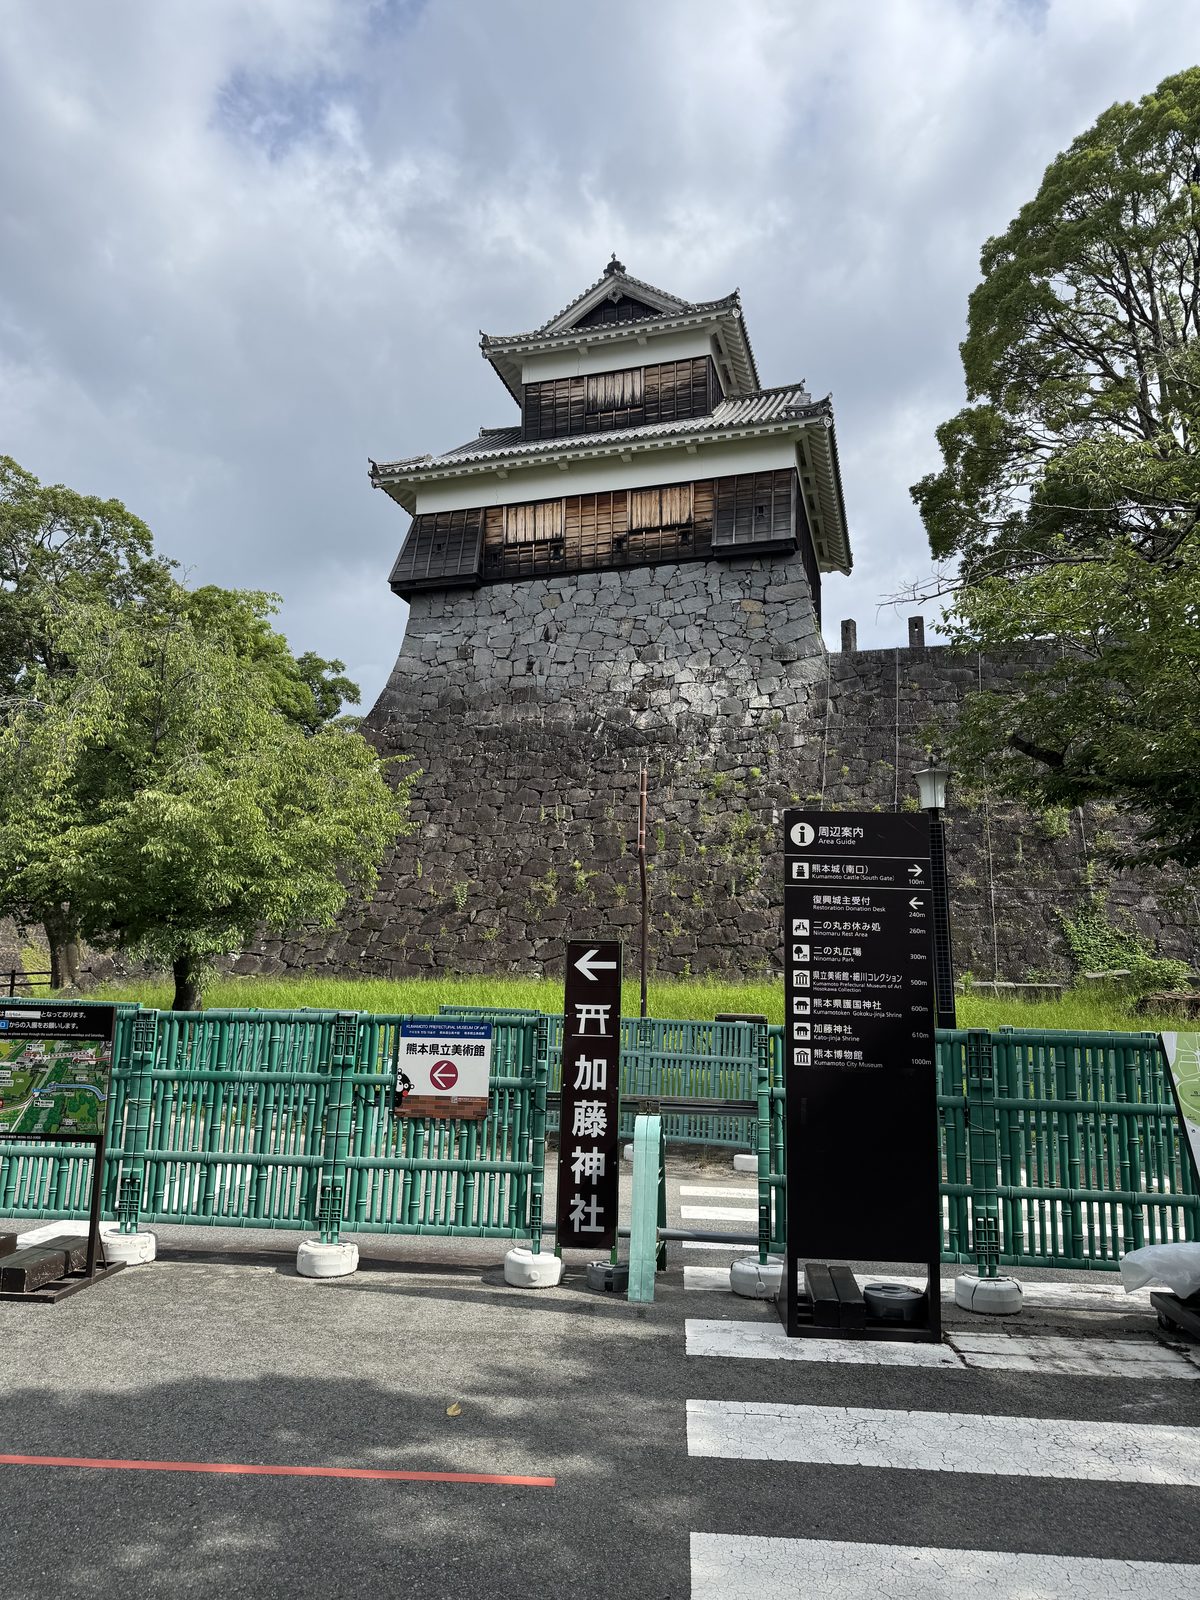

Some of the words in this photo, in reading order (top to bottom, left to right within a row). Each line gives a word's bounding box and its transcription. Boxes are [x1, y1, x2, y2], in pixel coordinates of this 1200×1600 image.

[818, 826, 864, 837] 周辺案内
[813, 895, 870, 905] 復興城主受付
[813, 921, 881, 931] 二の丸お休み処
[813, 946, 862, 957] 二の丸広場
[813, 998, 882, 1010] 熊本県護国神社
[853, 1010, 885, 1018] Gokoku-jinja
[813, 1024, 853, 1035] 加藤神社
[814, 1034, 841, 1042] Kato-jinja
[406, 1043, 486, 1056] 熊本県立美術館
[814, 1049, 863, 1060] 熊本博物館
[568, 1054, 607, 1233] 加藤神社
